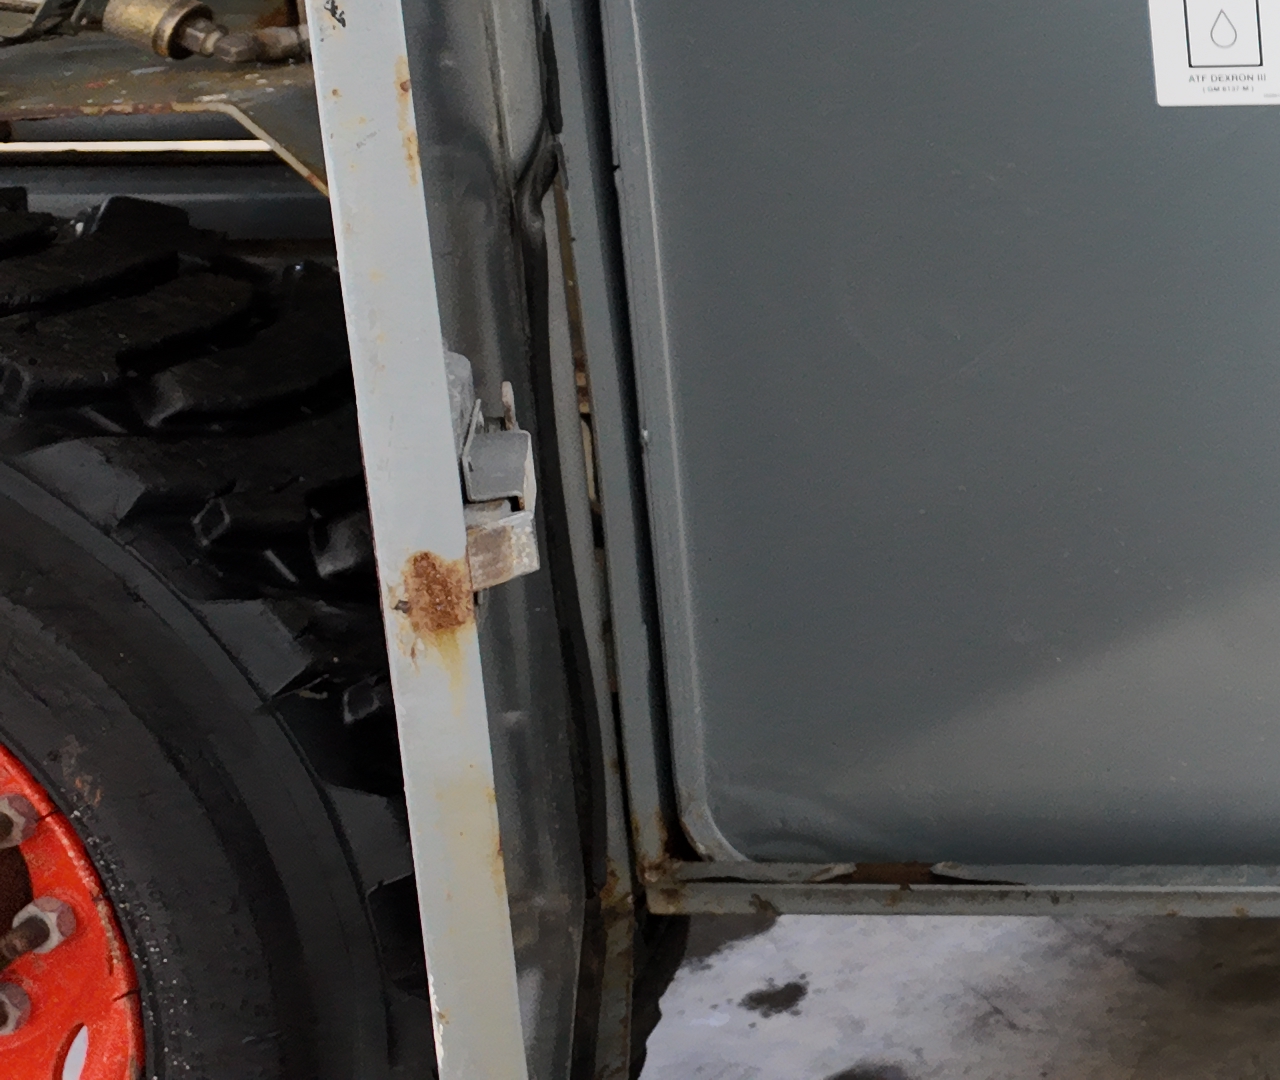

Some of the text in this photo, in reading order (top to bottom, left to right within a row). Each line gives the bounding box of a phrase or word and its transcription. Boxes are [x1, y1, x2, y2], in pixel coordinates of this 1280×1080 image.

[1188, 72, 1267, 83] ATF DEXRON III
